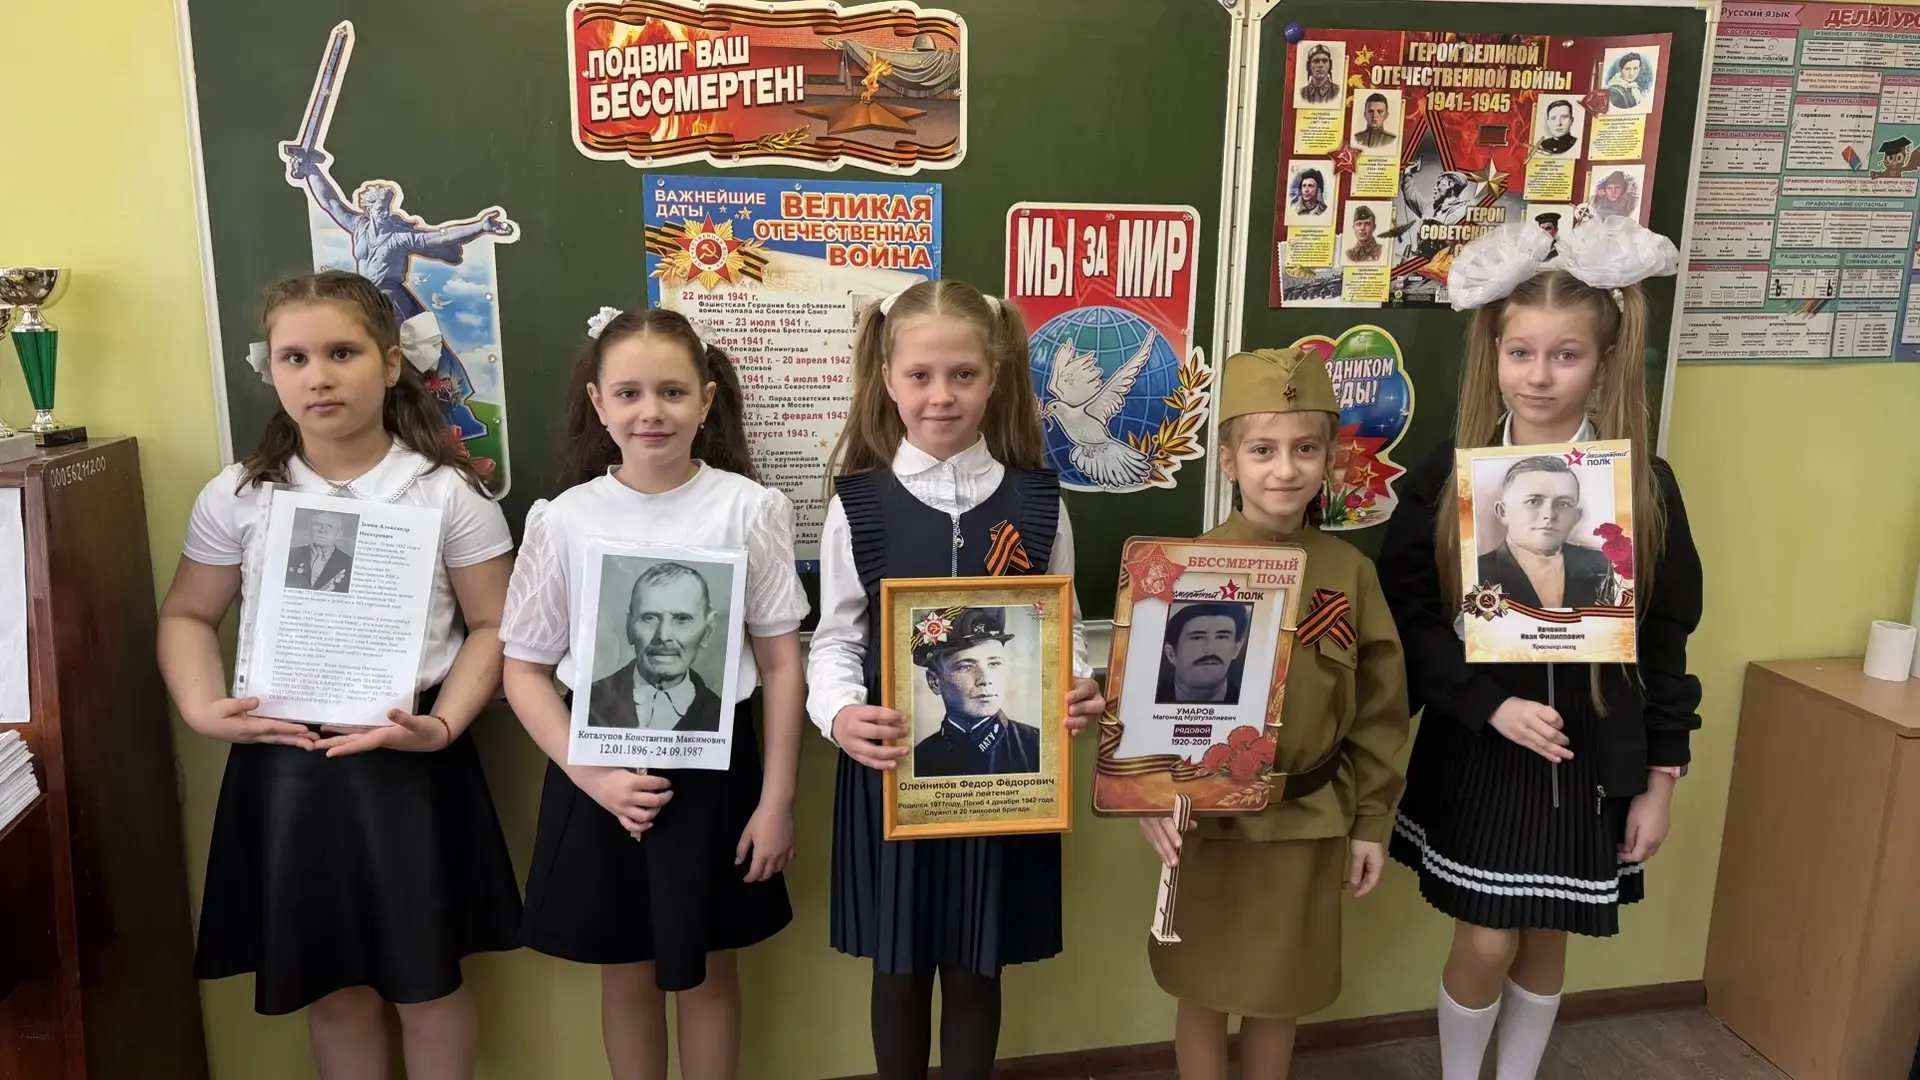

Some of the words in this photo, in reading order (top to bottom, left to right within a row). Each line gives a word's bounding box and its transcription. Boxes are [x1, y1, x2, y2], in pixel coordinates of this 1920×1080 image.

[1721, 6, 1763, 19] Русский
[1765, 10, 1791, 18] язык
[1824, 7, 1890, 29] ДЕЛАЙ
[589, 42, 689, 80] ПОДВИГ
[697, 36, 750, 69] ВАШ
[1409, 41, 1461, 64] ГЕРОИ
[1463, 42, 1540, 65] ВЕЛИКОЙ
[1371, 65, 1508, 90] ОТЕЧЕСТВЕННОЙ
[1509, 67, 1573, 91] ВОЙНЫ
[590, 65, 804, 121] БЕССМЕРТЕН!
[1426, 91, 1511, 113] 1941-1945
[655, 188, 766, 206] ВАЖНЕЙШИЕ
[655, 203, 704, 219] ДАТЫ
[781, 191, 933, 221] ВЕЛИКАЯ
[1466, 206, 1505, 222] ГЕРОИ
[753, 220, 932, 244] ОТЕЧЕСТВЕННАЯ
[828, 241, 932, 270] ВОЙНА
[1016, 217, 1076, 297] МЫ
[1081, 226, 1109, 277] ЗА
[1115, 219, 1188, 298] МИР
[683, 291, 694, 300] 22
[698, 293, 724, 301] июня
[728, 292, 748, 301] 1941
[735, 317, 747, 326] 23
[779, 318, 801, 326] 1941
[741, 336, 764, 345] 1941
[743, 355, 764, 364] 1941
[782, 355, 794, 364] 20
[796, 357, 828, 366] апреля
[830, 355, 851, 364] 1942
[1325, 357, 1394, 383] ЗДНИКОМ
[742, 374, 764, 383] 1941
[784, 375, 790, 383] 4
[821, 374, 844, 383] 1942
[773, 412, 779, 420] 2
[781, 412, 823, 422] февраля
[826, 411, 848, 420] 1943
[747, 431, 783, 440] августа
[787, 429, 809, 438] 1943
[811, 430, 818, 438] г.
[774, 456, 819, 464] крупнейшая
[1587, 458, 1611, 466] ПОЛК
[1187, 556, 1300, 571] БЕССМЕРТНЫЙ
[1256, 573, 1297, 585] ПОЛК
[1237, 591, 1264, 600] ПОЛК
[1176, 707, 1215, 715] УМАРОВ
[578, 730, 623, 742] Коталупов
[625, 733, 673, 743] Константин
[675, 733, 727, 745] Максимович
[1175, 727, 1211, 735] РЯДОВОЙ
[1171, 738, 1211, 746] 1920-2001
[599, 743, 648, 756] 12.01.1896
[655, 746, 703, 757] 24.09.1987
[899, 780, 957, 792] Олейников
[959, 779, 994, 789] Федор
[996, 777, 1056, 788] Фёдорович
[934, 790, 974, 800] Старший
[898, 802, 928, 810] Родился
[963, 799, 985, 807] Погиб
[992, 797, 1020, 807] декабря
[1021, 796, 1037, 805] 1942
[924, 809, 952, 817] Служил
[969, 806, 1000, 815] танковой
